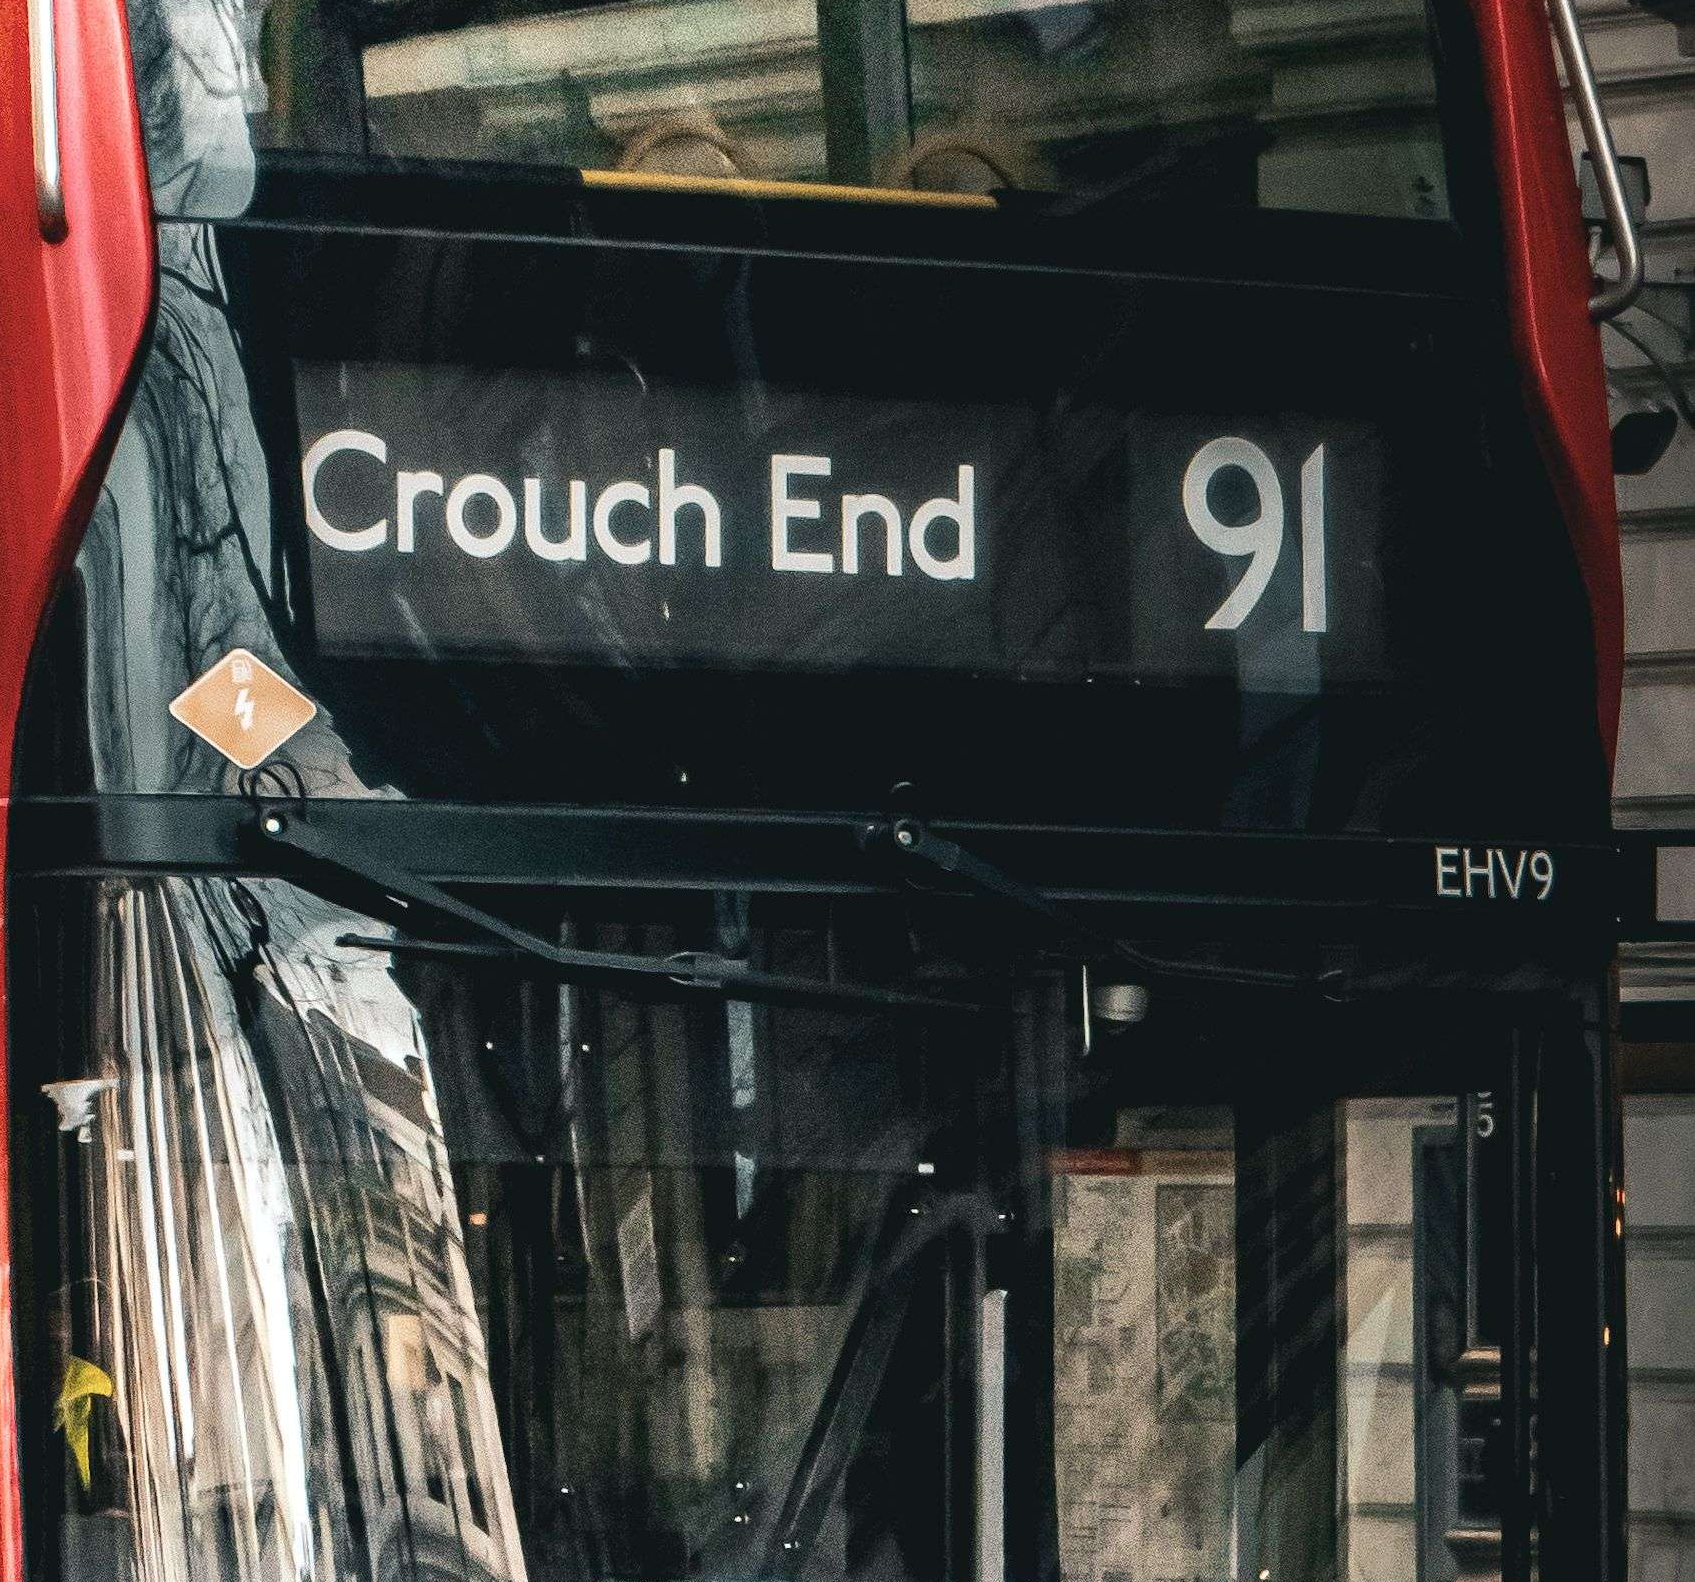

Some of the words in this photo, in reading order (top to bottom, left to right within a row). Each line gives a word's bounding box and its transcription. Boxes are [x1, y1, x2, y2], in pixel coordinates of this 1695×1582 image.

[303, 429, 721, 567] Crouch
[771, 453, 976, 581] End
[1182, 436, 1328, 634] 91
[1436, 847, 1556, 901] EHV9
